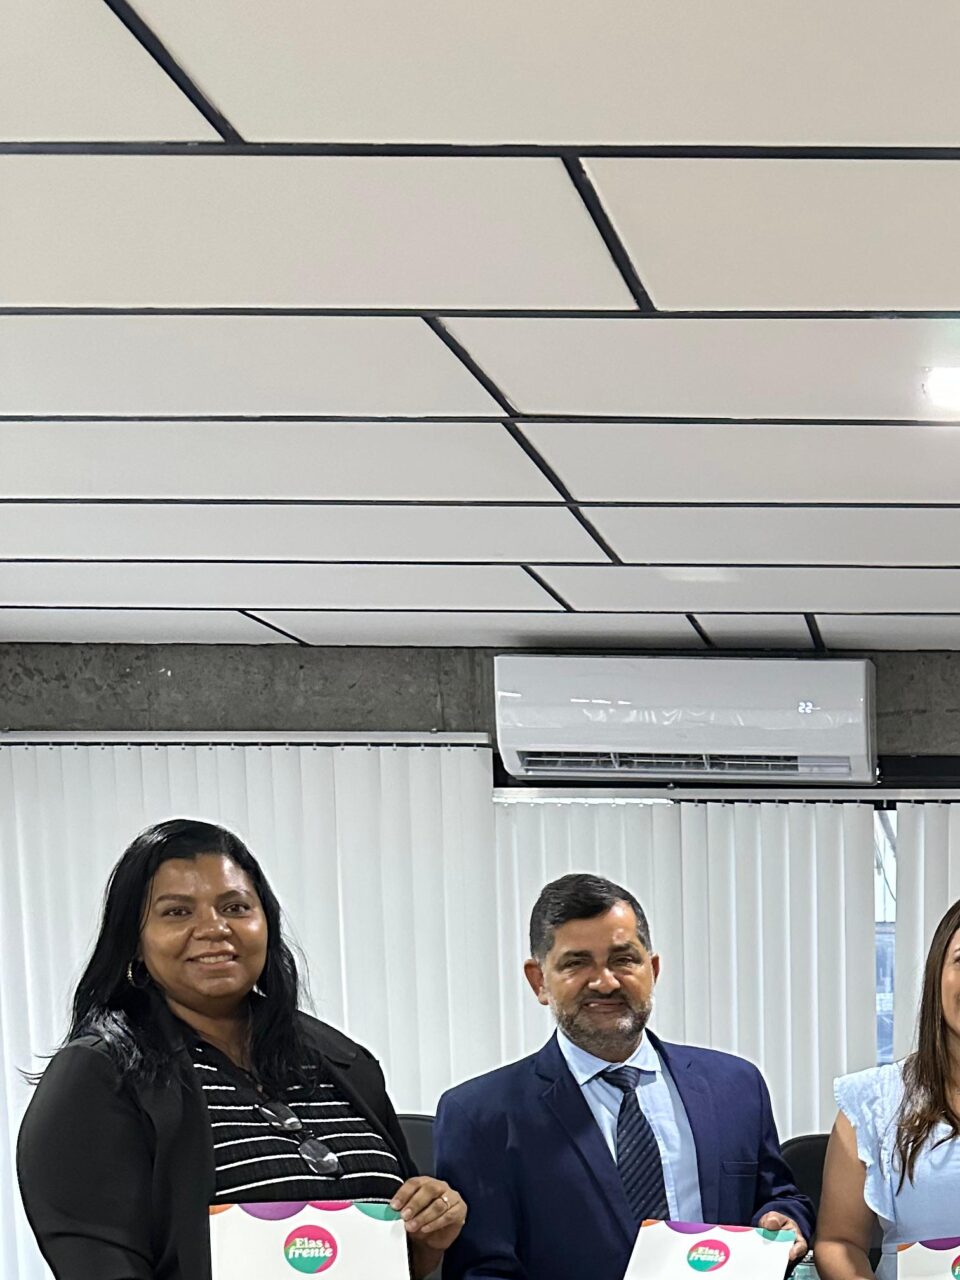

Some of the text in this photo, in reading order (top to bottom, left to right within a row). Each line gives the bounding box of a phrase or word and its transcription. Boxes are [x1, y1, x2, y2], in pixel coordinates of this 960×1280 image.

[798, 701, 813, 714] 22
[294, 1237, 323, 1249] Elas
[288, 1246, 333, 1259] frente
